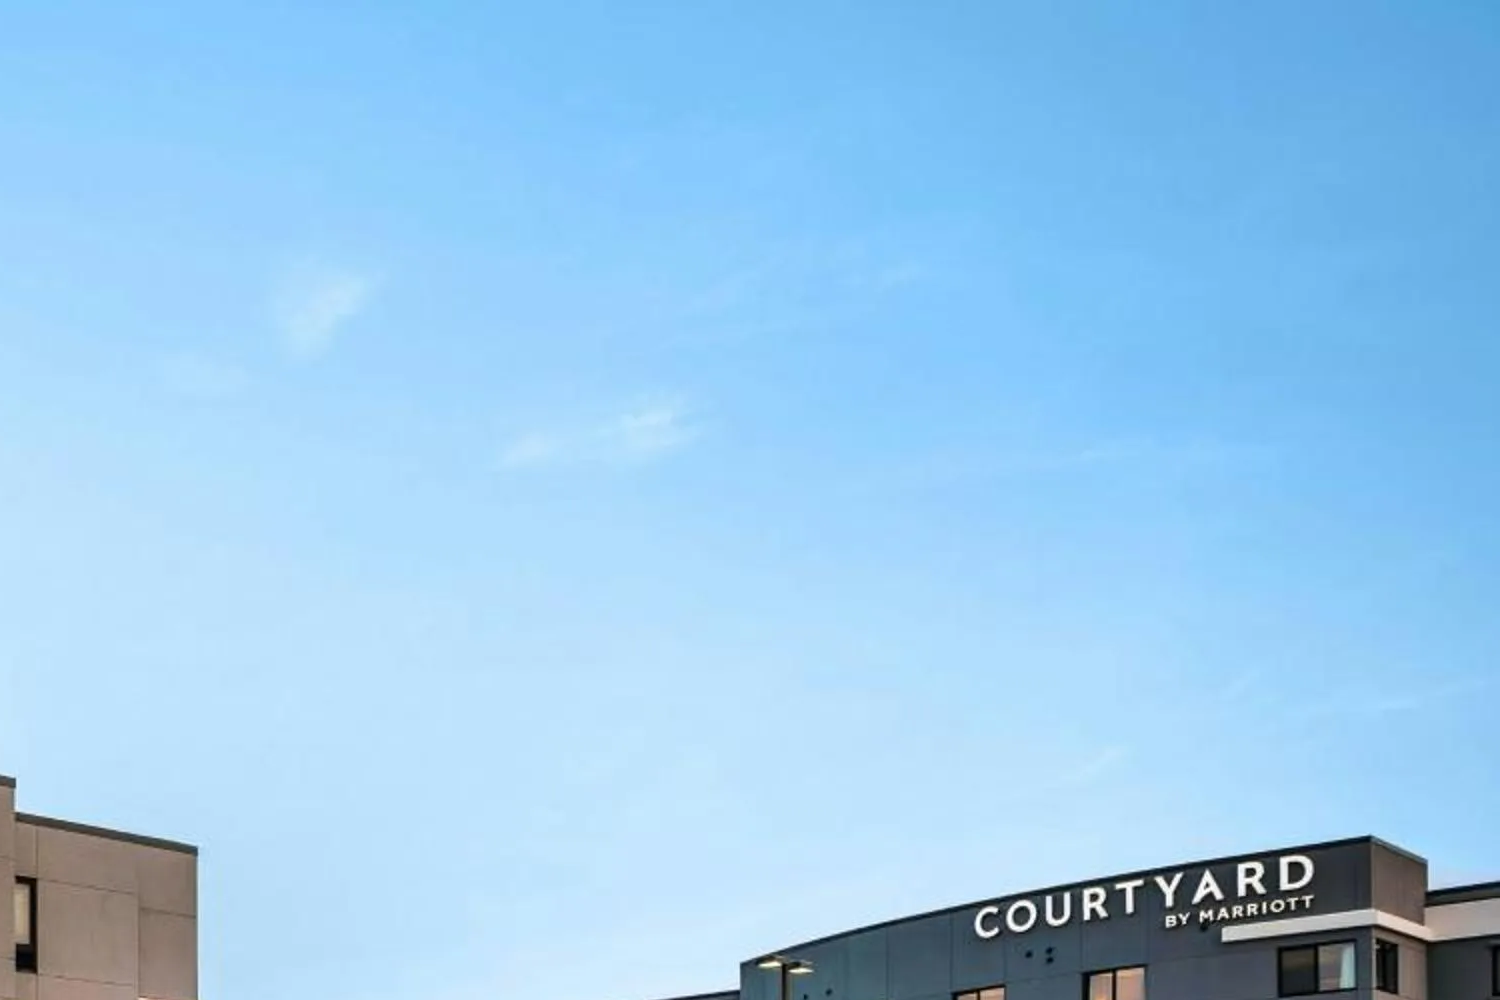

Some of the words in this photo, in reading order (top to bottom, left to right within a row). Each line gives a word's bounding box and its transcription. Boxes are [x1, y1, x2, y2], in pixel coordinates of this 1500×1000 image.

[973, 855, 1315, 939] COURTYARD
[1165, 911, 1192, 928] BY
[1199, 895, 1315, 923] MARRIOTT
